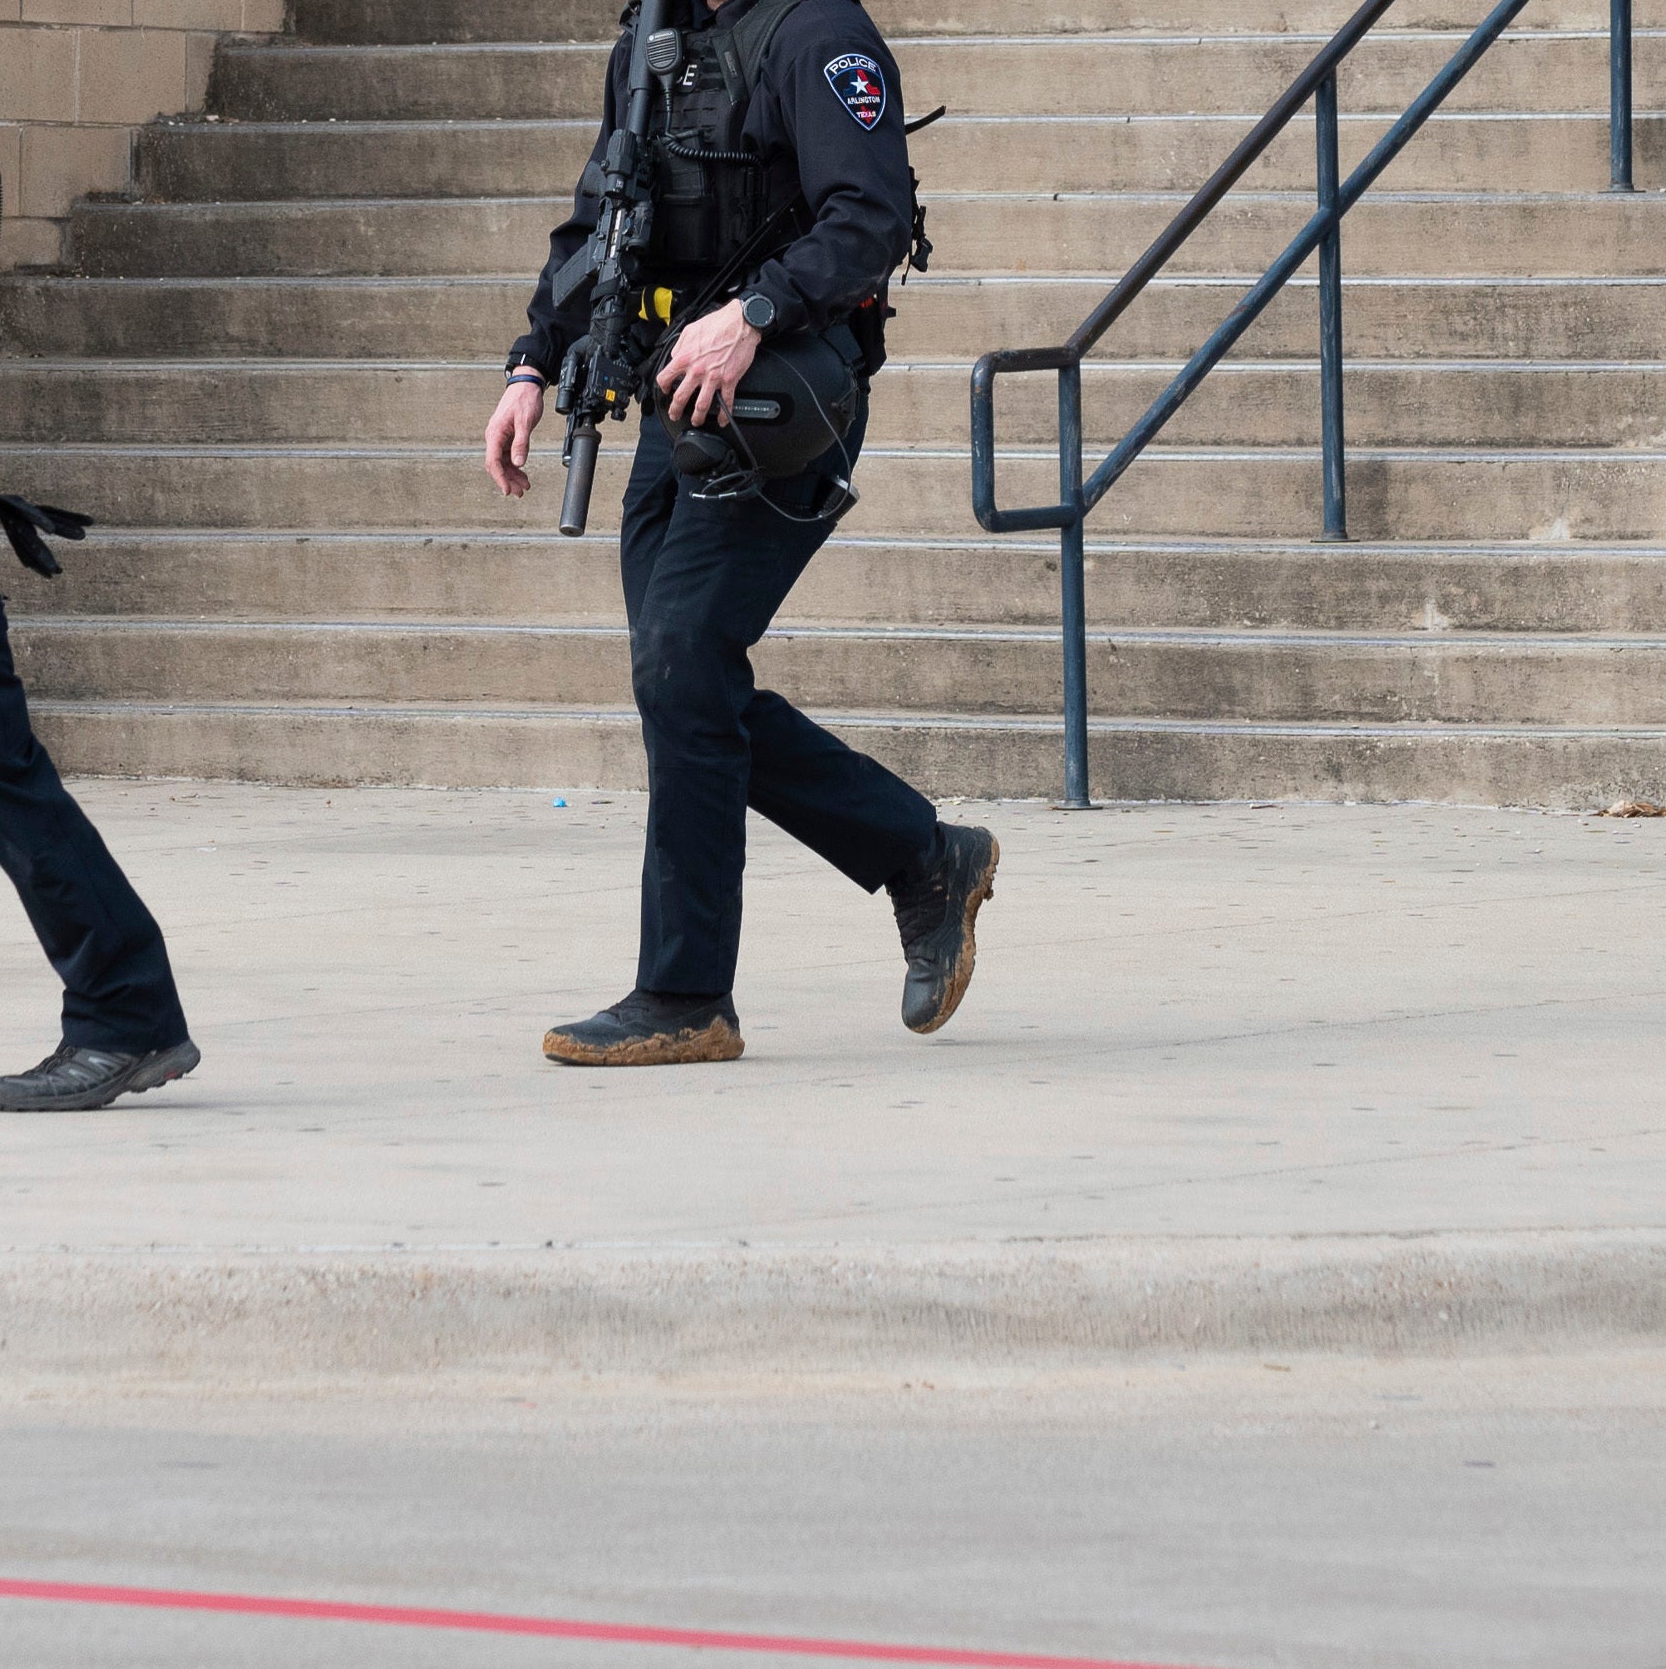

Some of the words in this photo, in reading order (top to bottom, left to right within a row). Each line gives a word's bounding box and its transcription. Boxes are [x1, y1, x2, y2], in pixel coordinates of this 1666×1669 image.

[829, 57, 877, 75] POLICE
[847, 95, 881, 105] ARLINGTON
[856, 110, 876, 118] TEXAS
